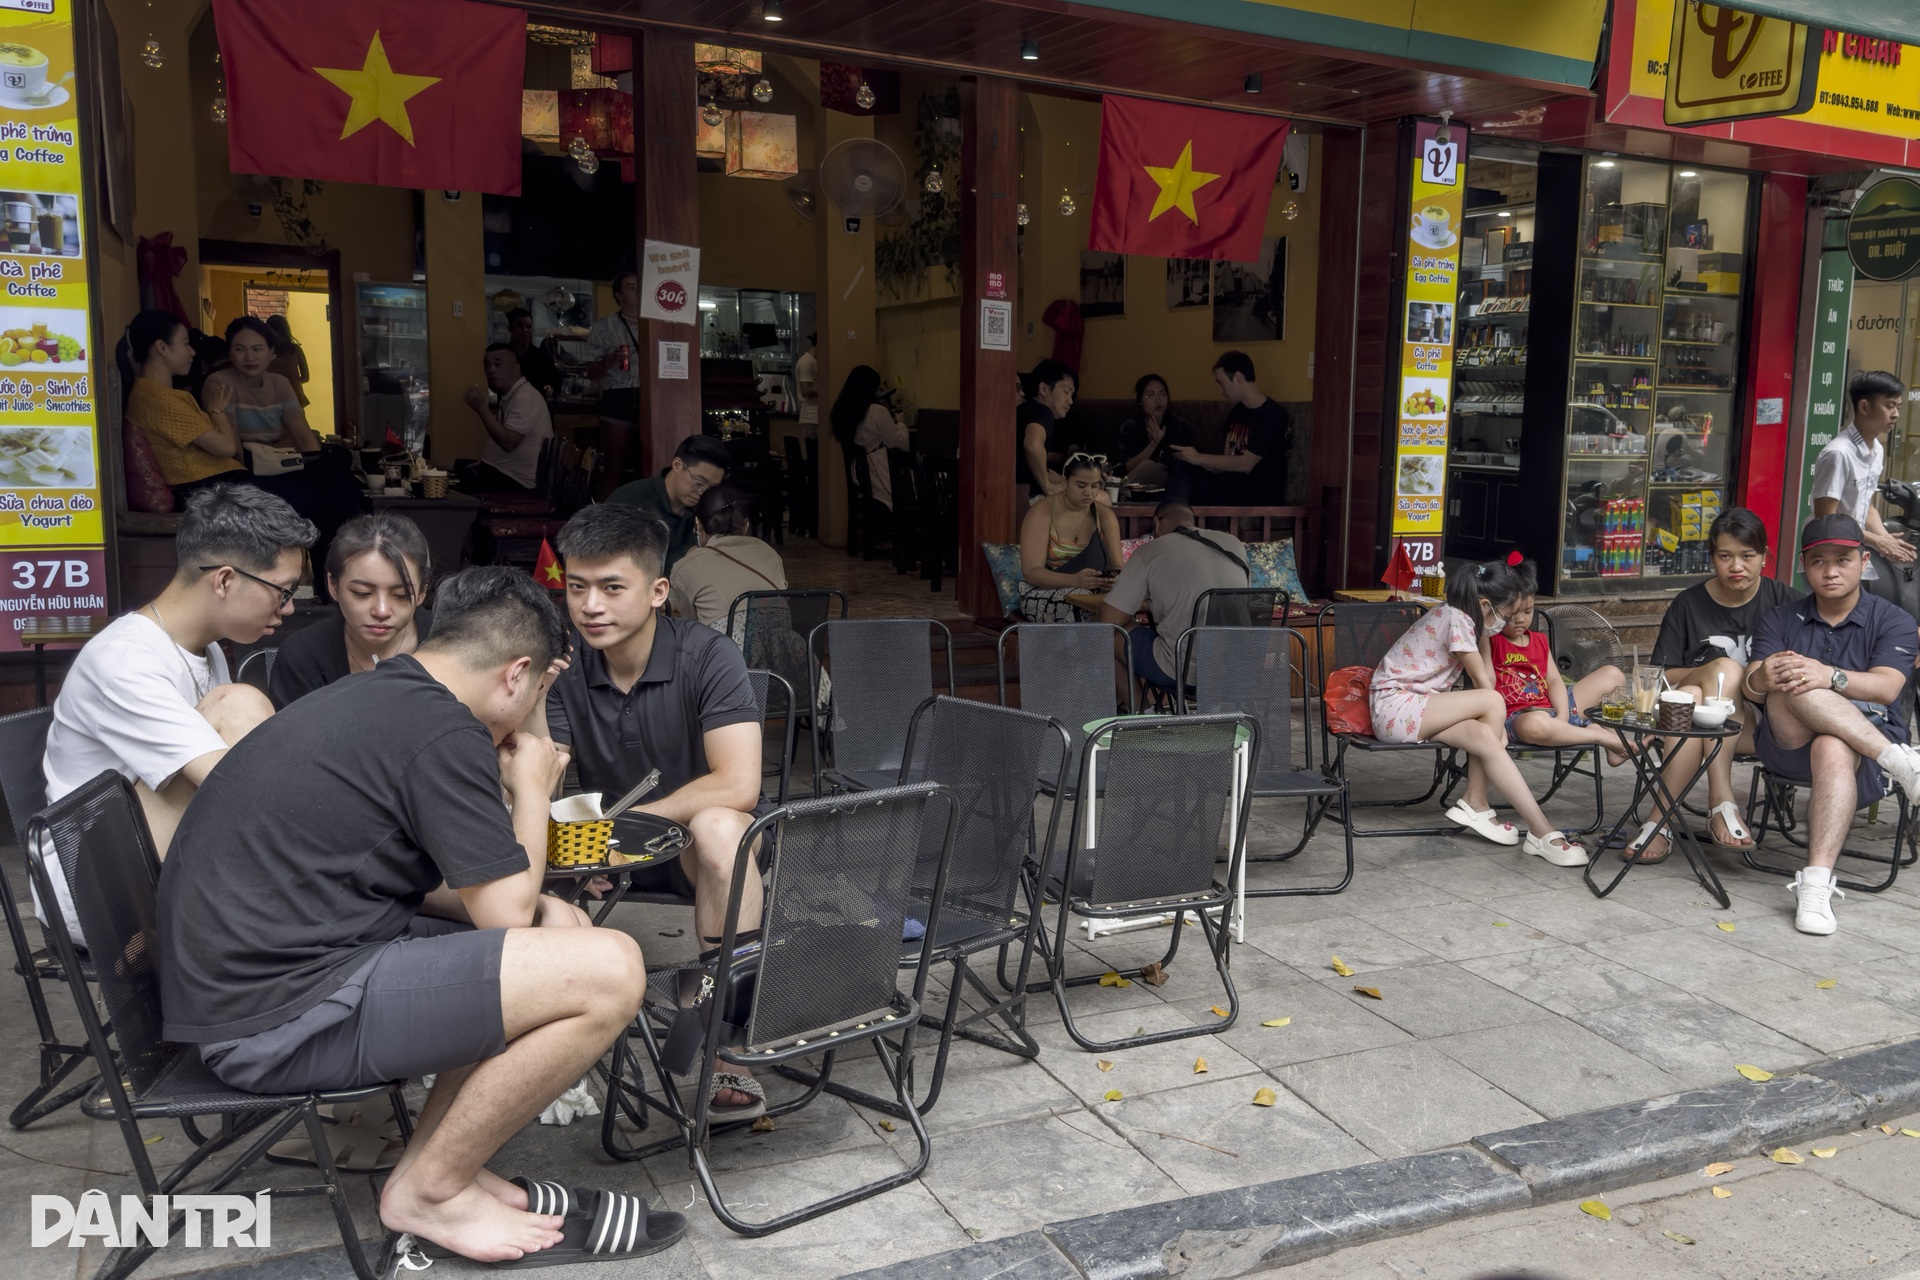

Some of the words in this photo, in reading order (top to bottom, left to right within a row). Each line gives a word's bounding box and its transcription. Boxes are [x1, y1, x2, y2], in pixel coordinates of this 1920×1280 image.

[1739, 70, 1783, 90] COFFEE
[1, 123, 26, 140] phê
[32, 125, 73, 145] trứng
[16, 148, 64, 163] Coffee
[0, 261, 24, 276] Cà
[31, 263, 62, 280] phê
[8, 283, 56, 297] Coffee
[21, 380, 32, 397] ép
[48, 380, 72, 395] Sinh
[75, 377, 87, 396] tố
[12, 398, 34, 411] Juice
[0, 493, 25, 510] Sữa
[31, 495, 64, 509] chua
[20, 514, 72, 528] Yogurt
[1408, 512, 1430, 521] Yogurt
[12, 560, 90, 589] 37B
[0, 594, 45, 611] NGUYỄN
[48, 595, 71, 610] HỮU
[74, 594, 104, 609] HUÂN
